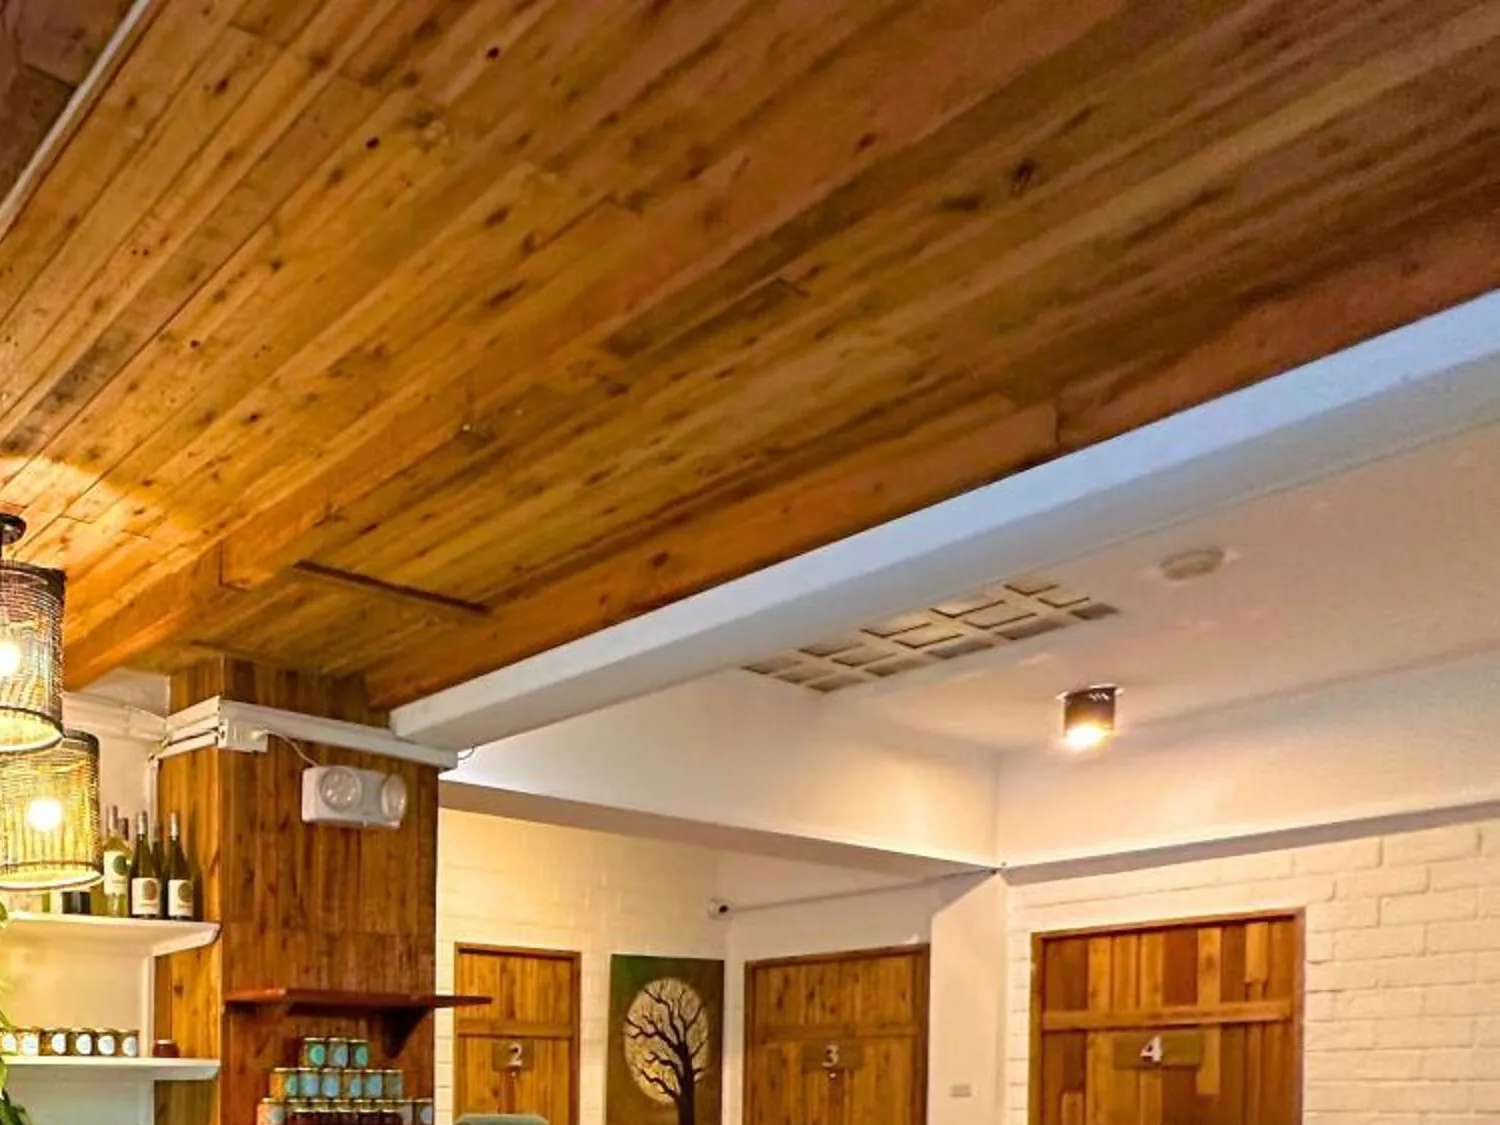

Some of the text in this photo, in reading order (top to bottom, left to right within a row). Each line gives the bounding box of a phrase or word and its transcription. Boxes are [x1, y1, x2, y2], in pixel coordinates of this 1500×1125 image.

[508, 1042, 522, 1067] 2
[822, 1044, 838, 1067] 3
[1140, 1036, 1163, 1063] 4
